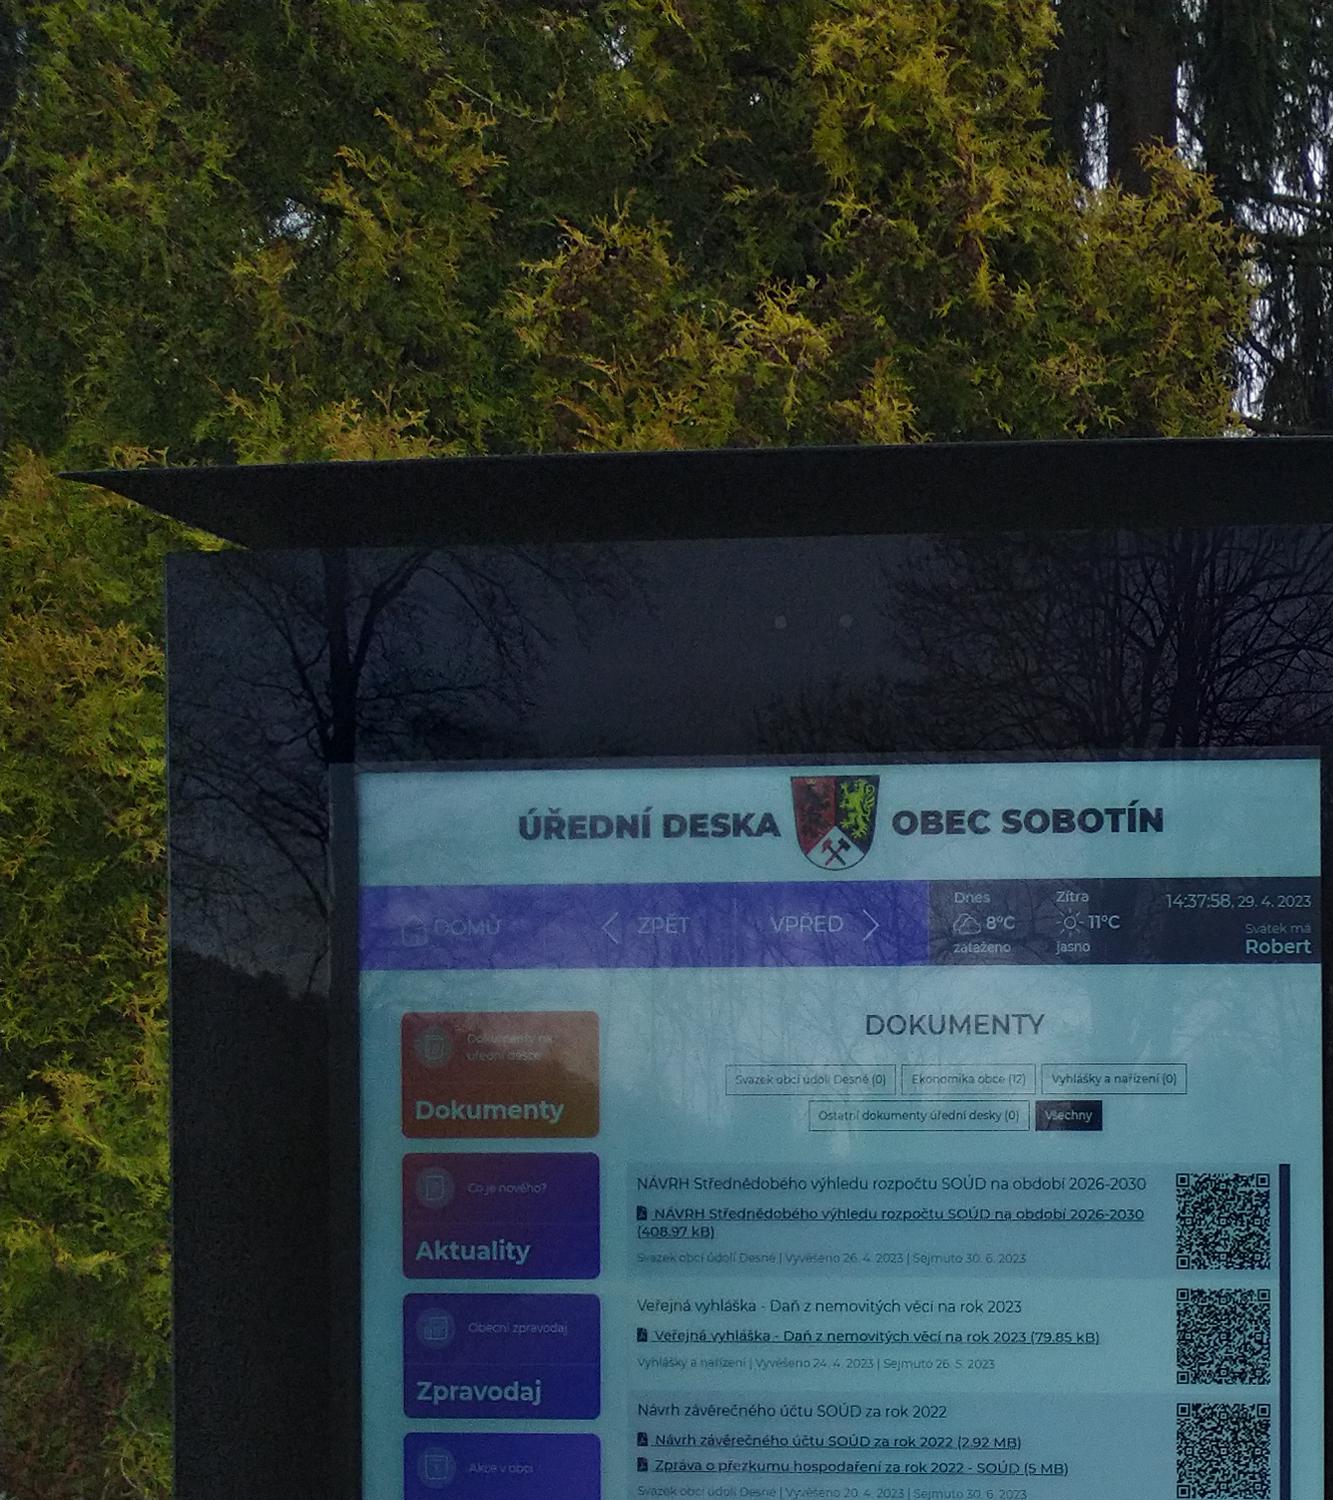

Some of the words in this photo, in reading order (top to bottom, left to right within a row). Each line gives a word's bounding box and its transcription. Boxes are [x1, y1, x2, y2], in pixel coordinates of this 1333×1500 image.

[518, 807, 653, 841] ÚŘEDNÍ
[662, 812, 781, 838] DESKA
[891, 810, 991, 836] OBEC
[1001, 800, 1164, 834] SOBOTÍN
[953, 891, 990, 904] Dnes
[1056, 890, 1089, 903] Zítra
[1165, 894, 1234, 909] 14:37:58,
[1237, 896, 1258, 908] 29.
[1261, 896, 1272, 908] 4.
[1277, 894, 1312, 908] 2023
[637, 914, 691, 935] ZPĚT
[770, 912, 843, 933] VPŘED
[985, 915, 1016, 931] 8°C
[1088, 914, 1121, 930] 11°C
[953, 940, 1012, 955] zataženo
[1056, 941, 1091, 955] jasno
[1245, 939, 1312, 955] Robert
[865, 1013, 1045, 1036] DOKUMENTY
[415, 1100, 565, 1124] Dokumenty
[1044, 1108, 1092, 1123] Všechny
[636, 1174, 689, 1190] NÁVRH
[693, 1176, 807, 1190] Střednědobého
[810, 1176, 868, 1193] výhledu
[872, 1177, 937, 1193] rozpočtu
[941, 1175, 987, 1190] SOÚD
[990, 1180, 1009, 1190] na
[1011, 1177, 1065, 1190] období
[1068, 1177, 1147, 1190] 2026-2030
[415, 1239, 530, 1265] Aktuality
[636, 1298, 691, 1314] Veřejná
[694, 1298, 757, 1315] vyhláška
[769, 1299, 800, 1312] Daň
[803, 1303, 811, 1312] z
[814, 1299, 901, 1315] nemovitých
[903, 1300, 933, 1313] věcí
[937, 1303, 956, 1313] na
[959, 1300, 984, 1313] rok
[987, 1300, 1023, 1313] 2023
[416, 1379, 542, 1406] Zpravodaj
[636, 1402, 680, 1416] Návrh
[683, 1403, 776, 1417] závěrečného
[779, 1404, 813, 1417] účtu
[816, 1402, 862, 1418] SOÚD
[865, 1408, 881, 1418] za
[884, 1405, 909, 1418] rok
[912, 1405, 948, 1418] 2022
